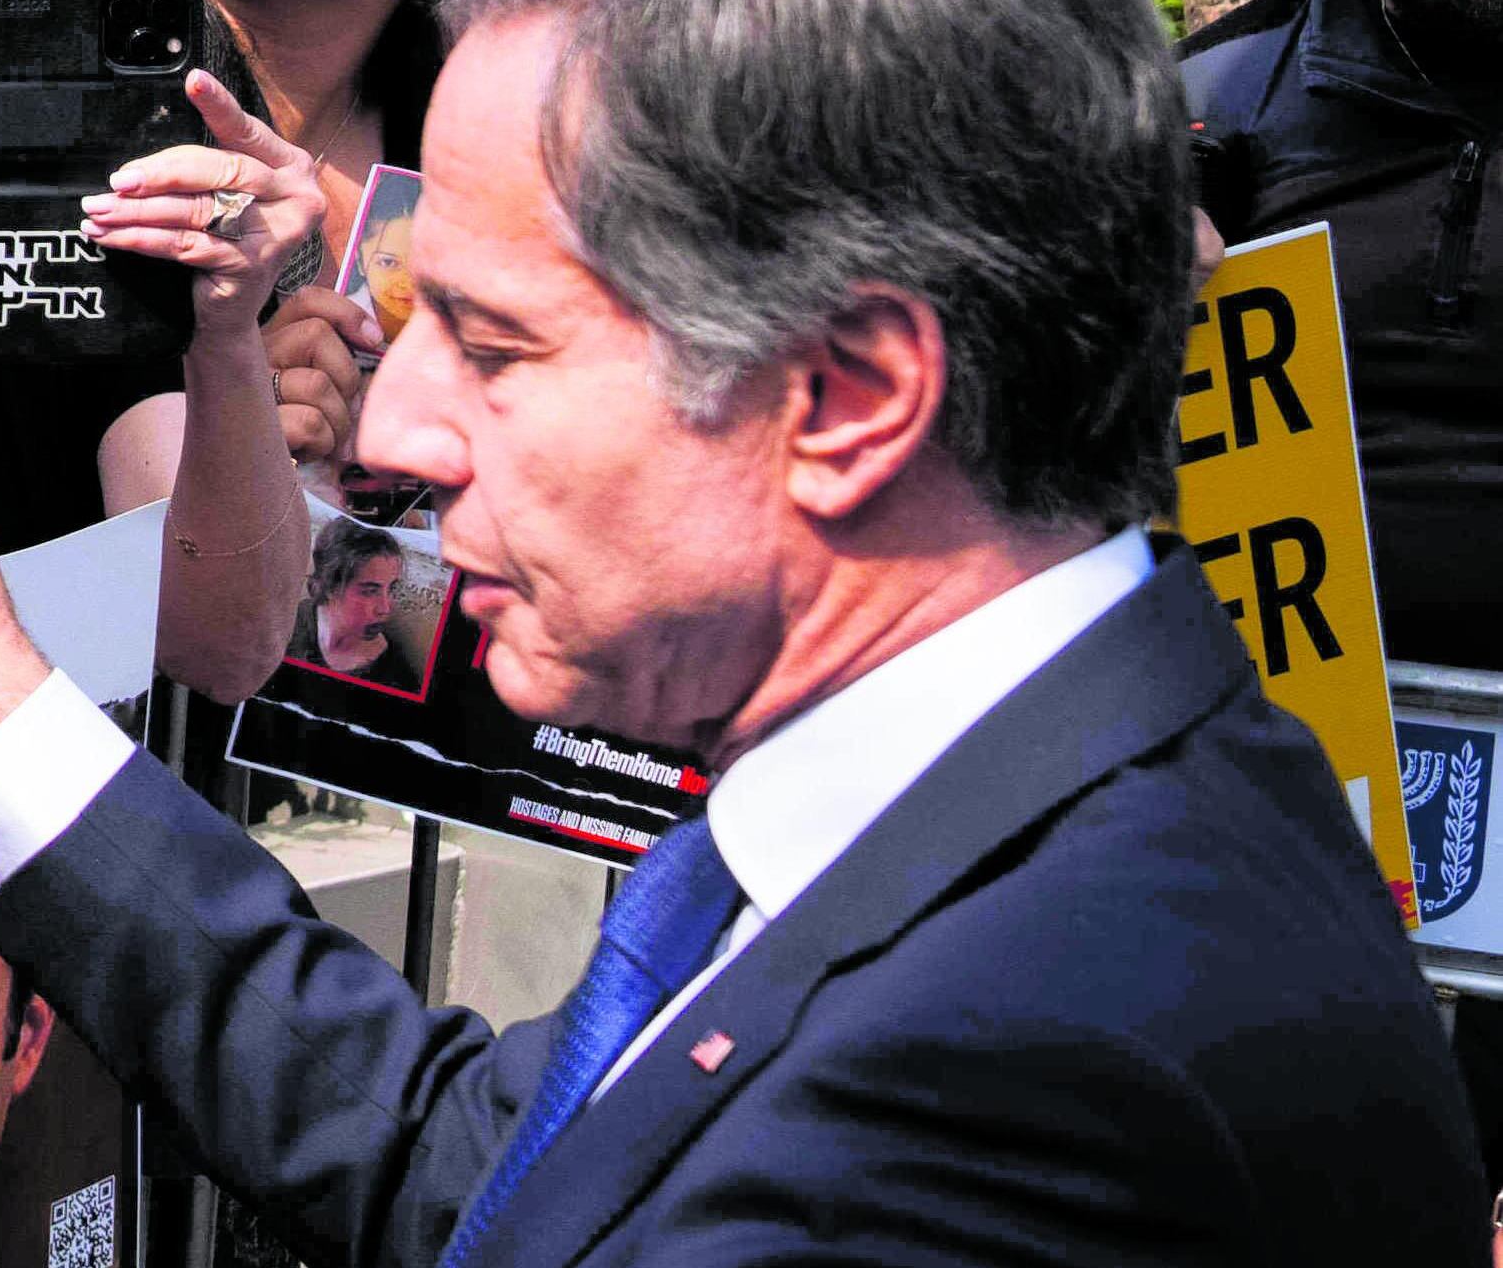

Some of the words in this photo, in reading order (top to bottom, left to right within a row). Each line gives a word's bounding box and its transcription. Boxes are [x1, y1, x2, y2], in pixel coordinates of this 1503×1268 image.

[510, 796, 559, 824] HOSTAGES
[558, 809, 581, 830] AND
[580, 814, 623, 841] MISSING
